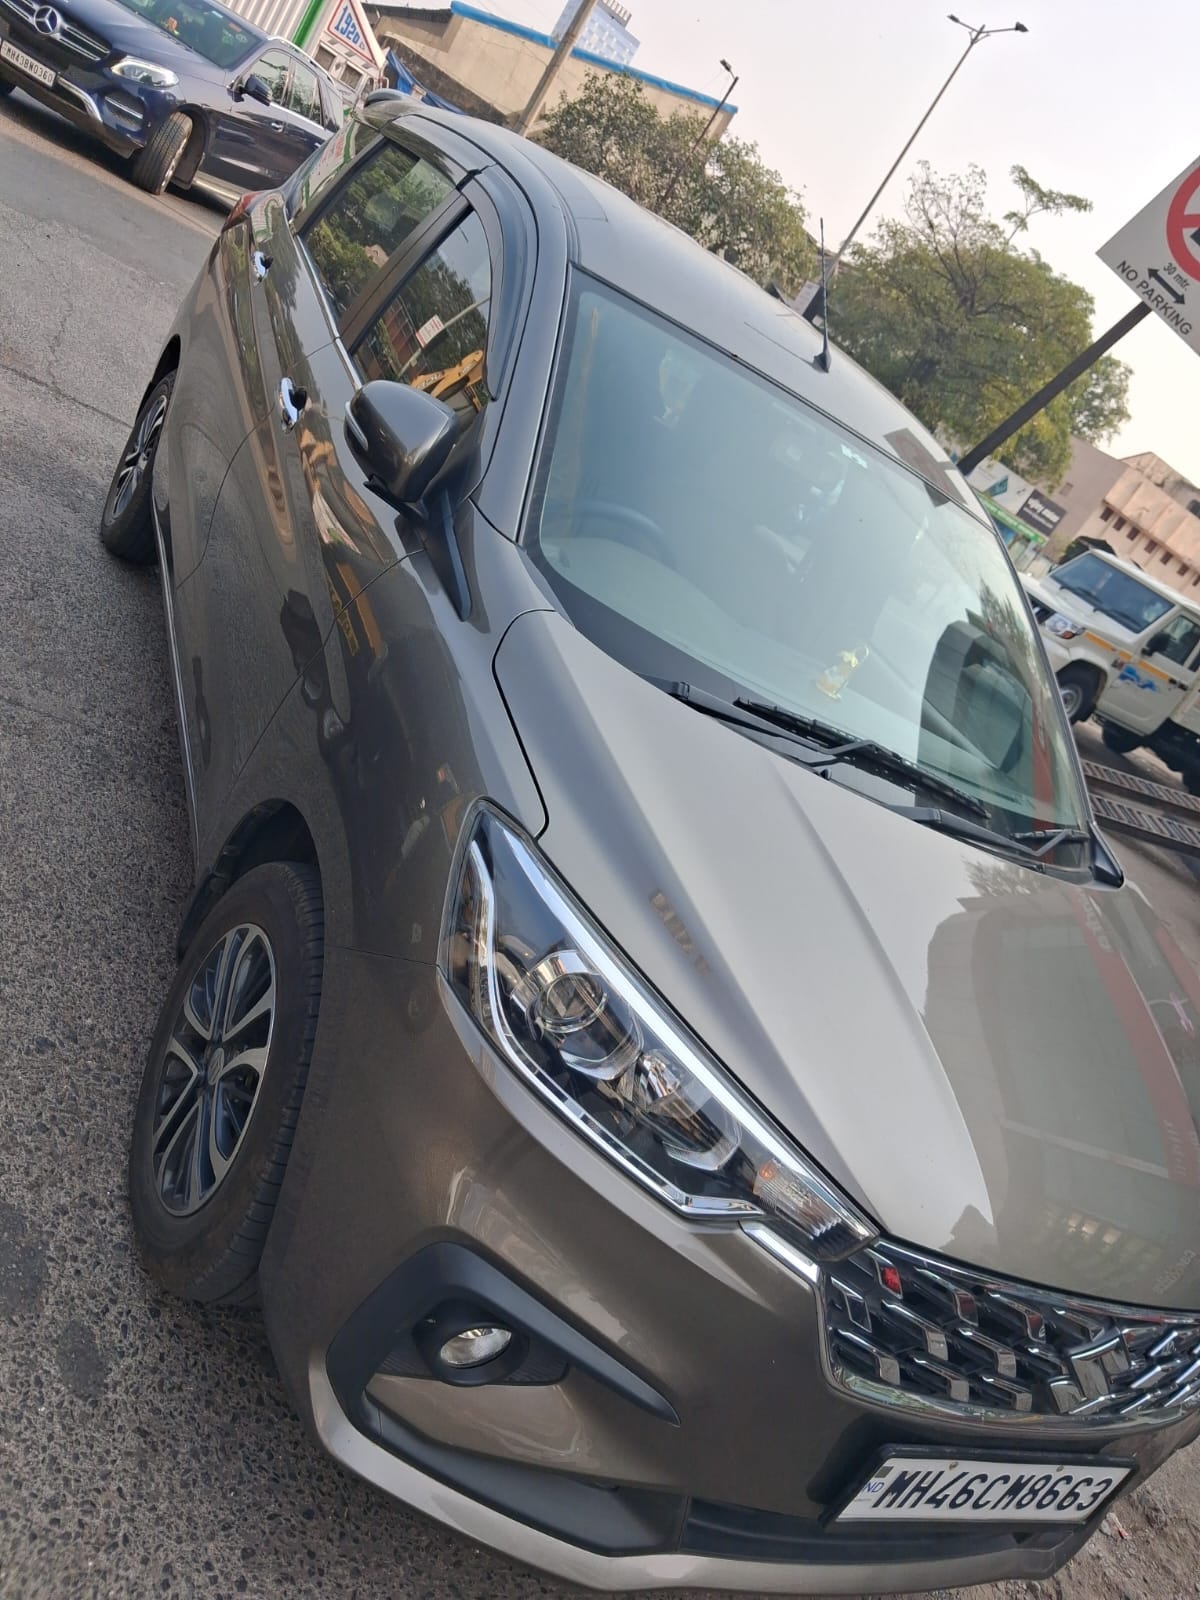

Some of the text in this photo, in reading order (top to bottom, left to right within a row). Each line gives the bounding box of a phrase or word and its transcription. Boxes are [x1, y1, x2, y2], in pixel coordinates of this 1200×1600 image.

[1163, 262, 1177, 276] 30
[1116, 260, 1192, 335] NO PARKING
[862, 1481, 885, 1493] ND
[872, 1471, 1112, 1511] MH46CM8663
